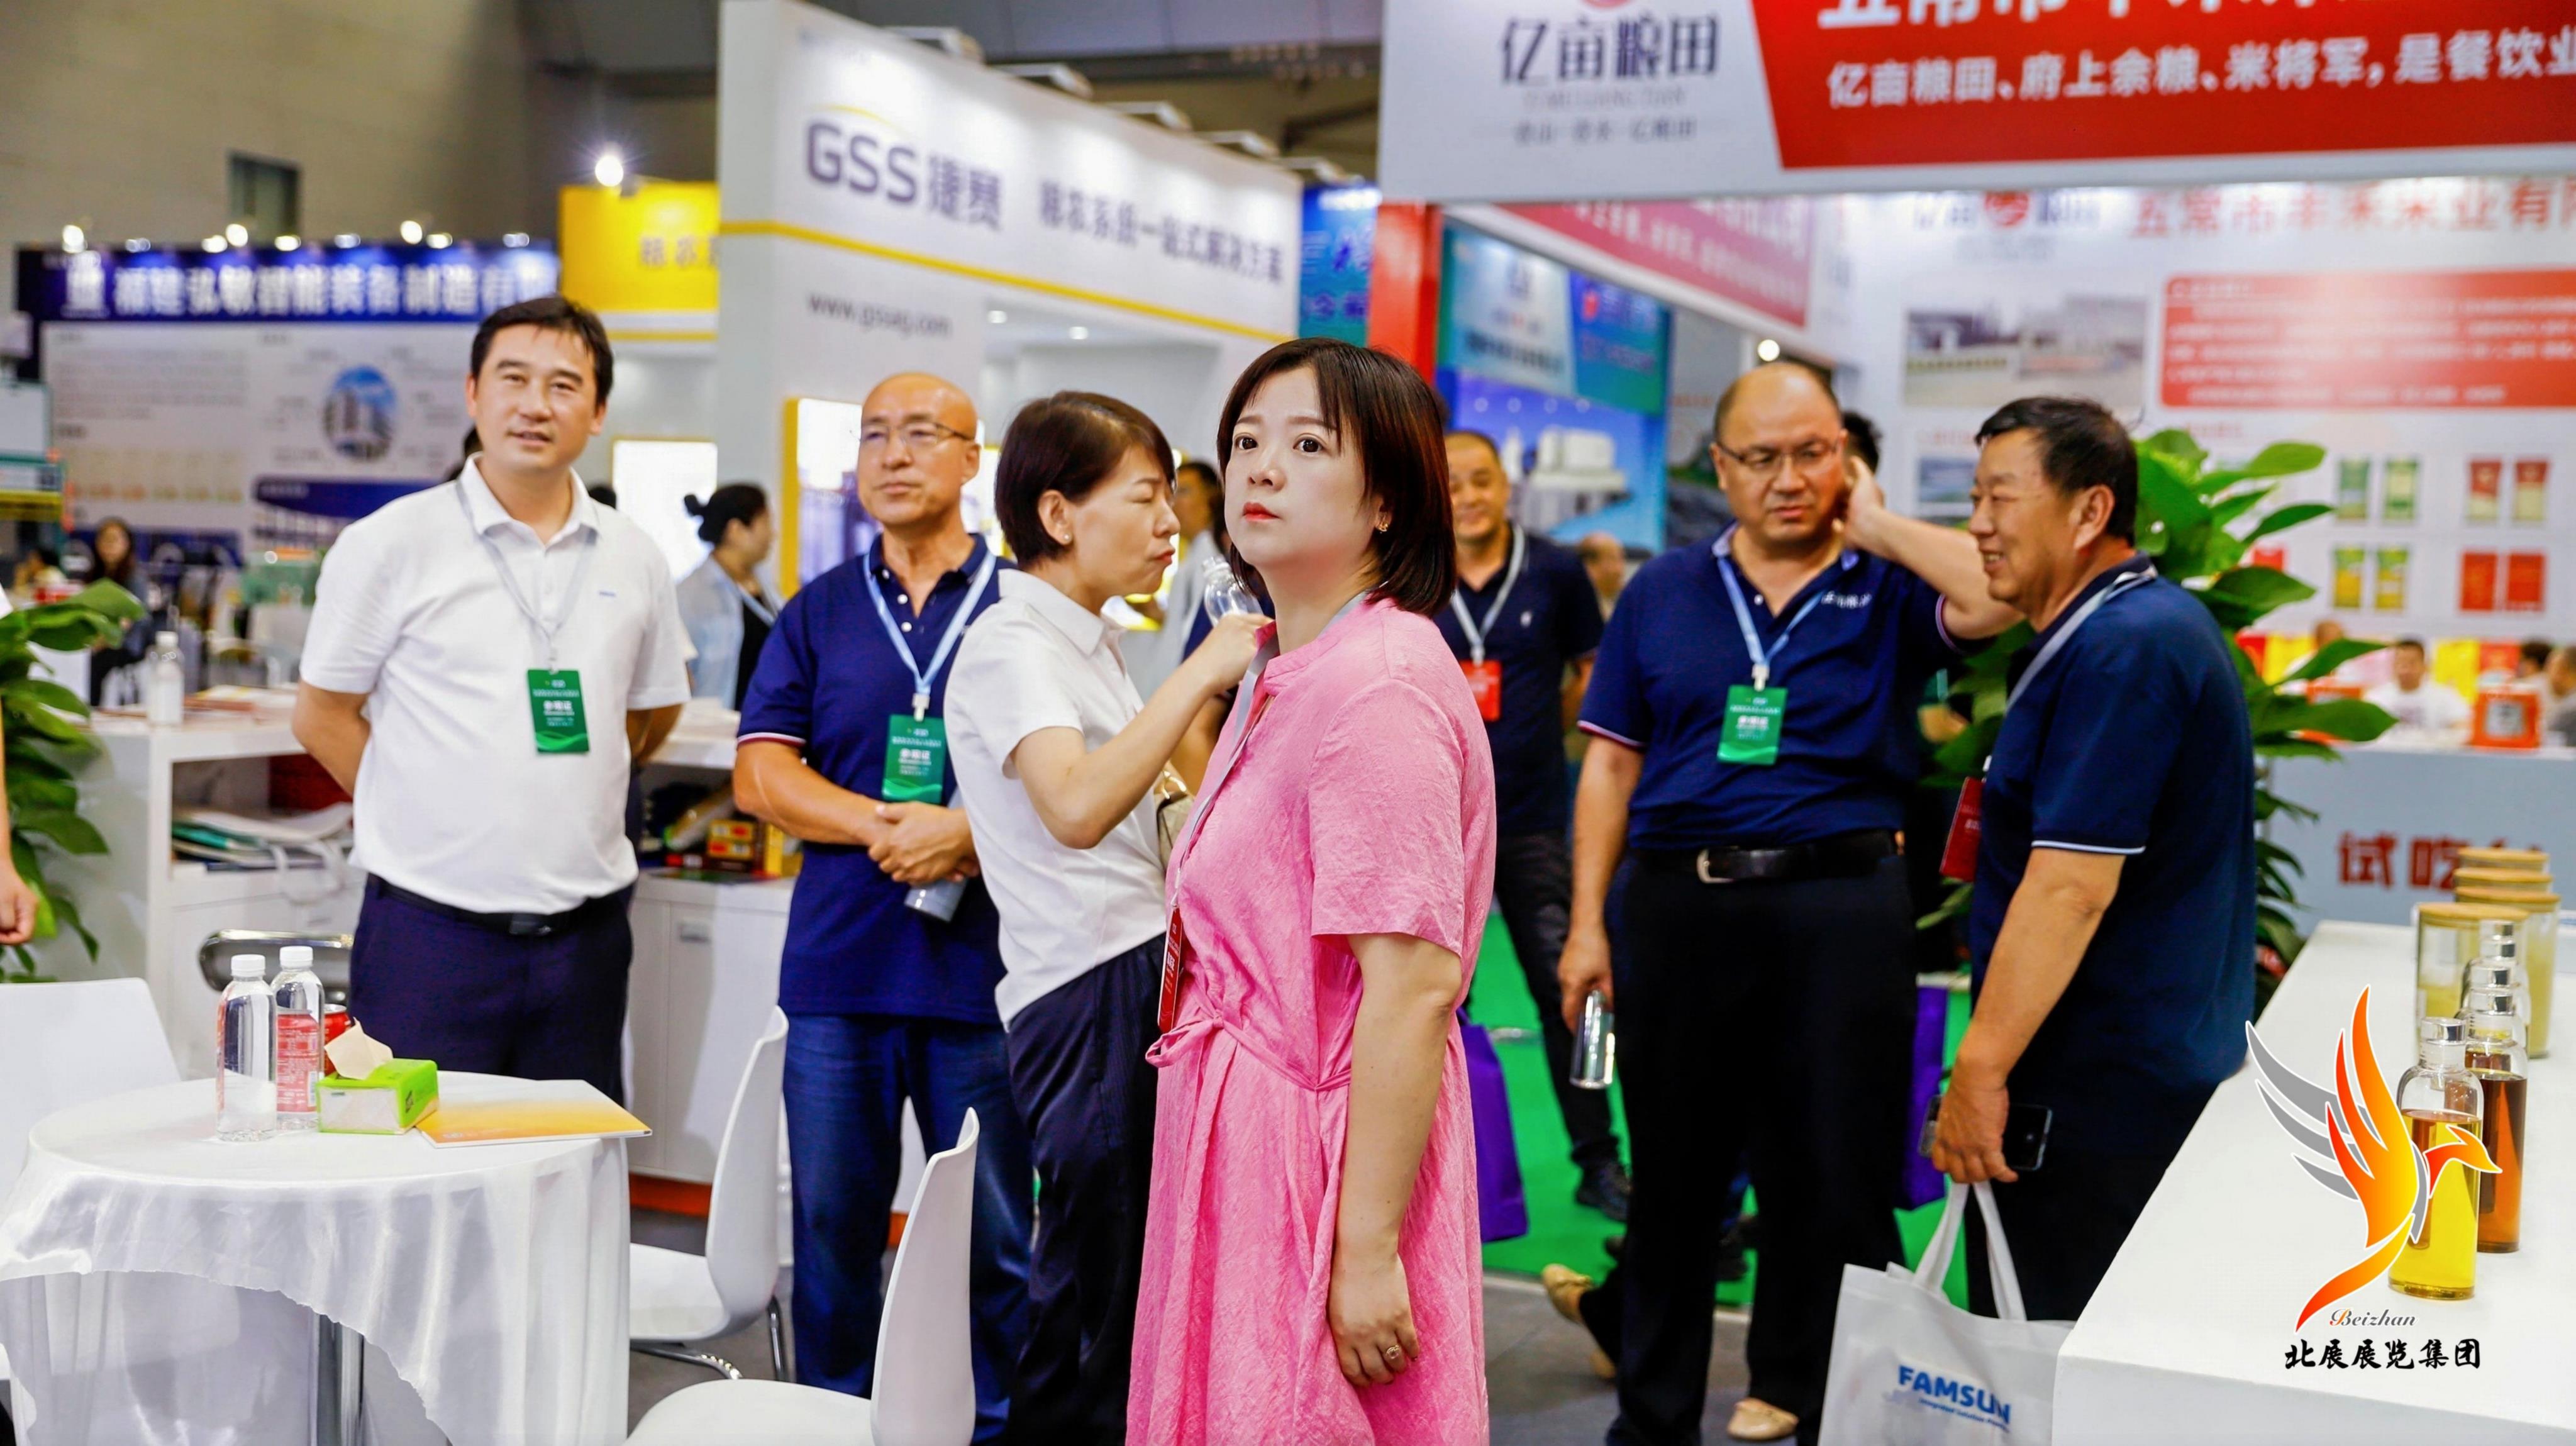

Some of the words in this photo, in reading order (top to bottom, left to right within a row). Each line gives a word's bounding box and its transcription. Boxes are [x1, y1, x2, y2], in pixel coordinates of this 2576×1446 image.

[1501, 17, 1720, 83] 亿亩粮田
[808, 122, 917, 204] GSS
[1899, 1365, 2011, 1425] FAMSUN
